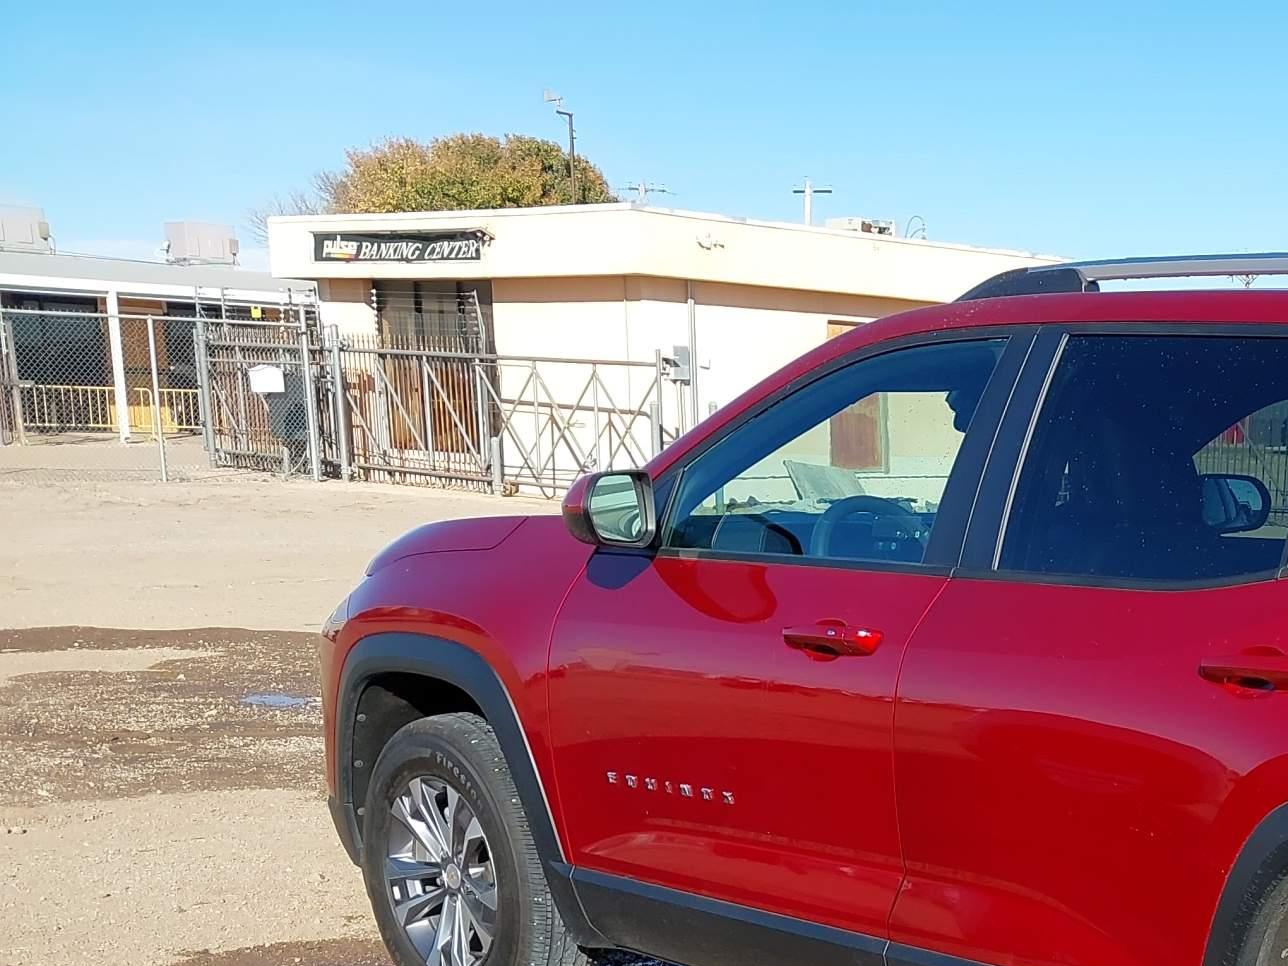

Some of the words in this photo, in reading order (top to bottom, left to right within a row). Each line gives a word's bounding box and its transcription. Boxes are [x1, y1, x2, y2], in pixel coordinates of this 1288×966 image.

[359, 241, 422, 260] BANKING
[424, 238, 478, 260] CENTER
[606, 771, 736, 805] EQUINOX
